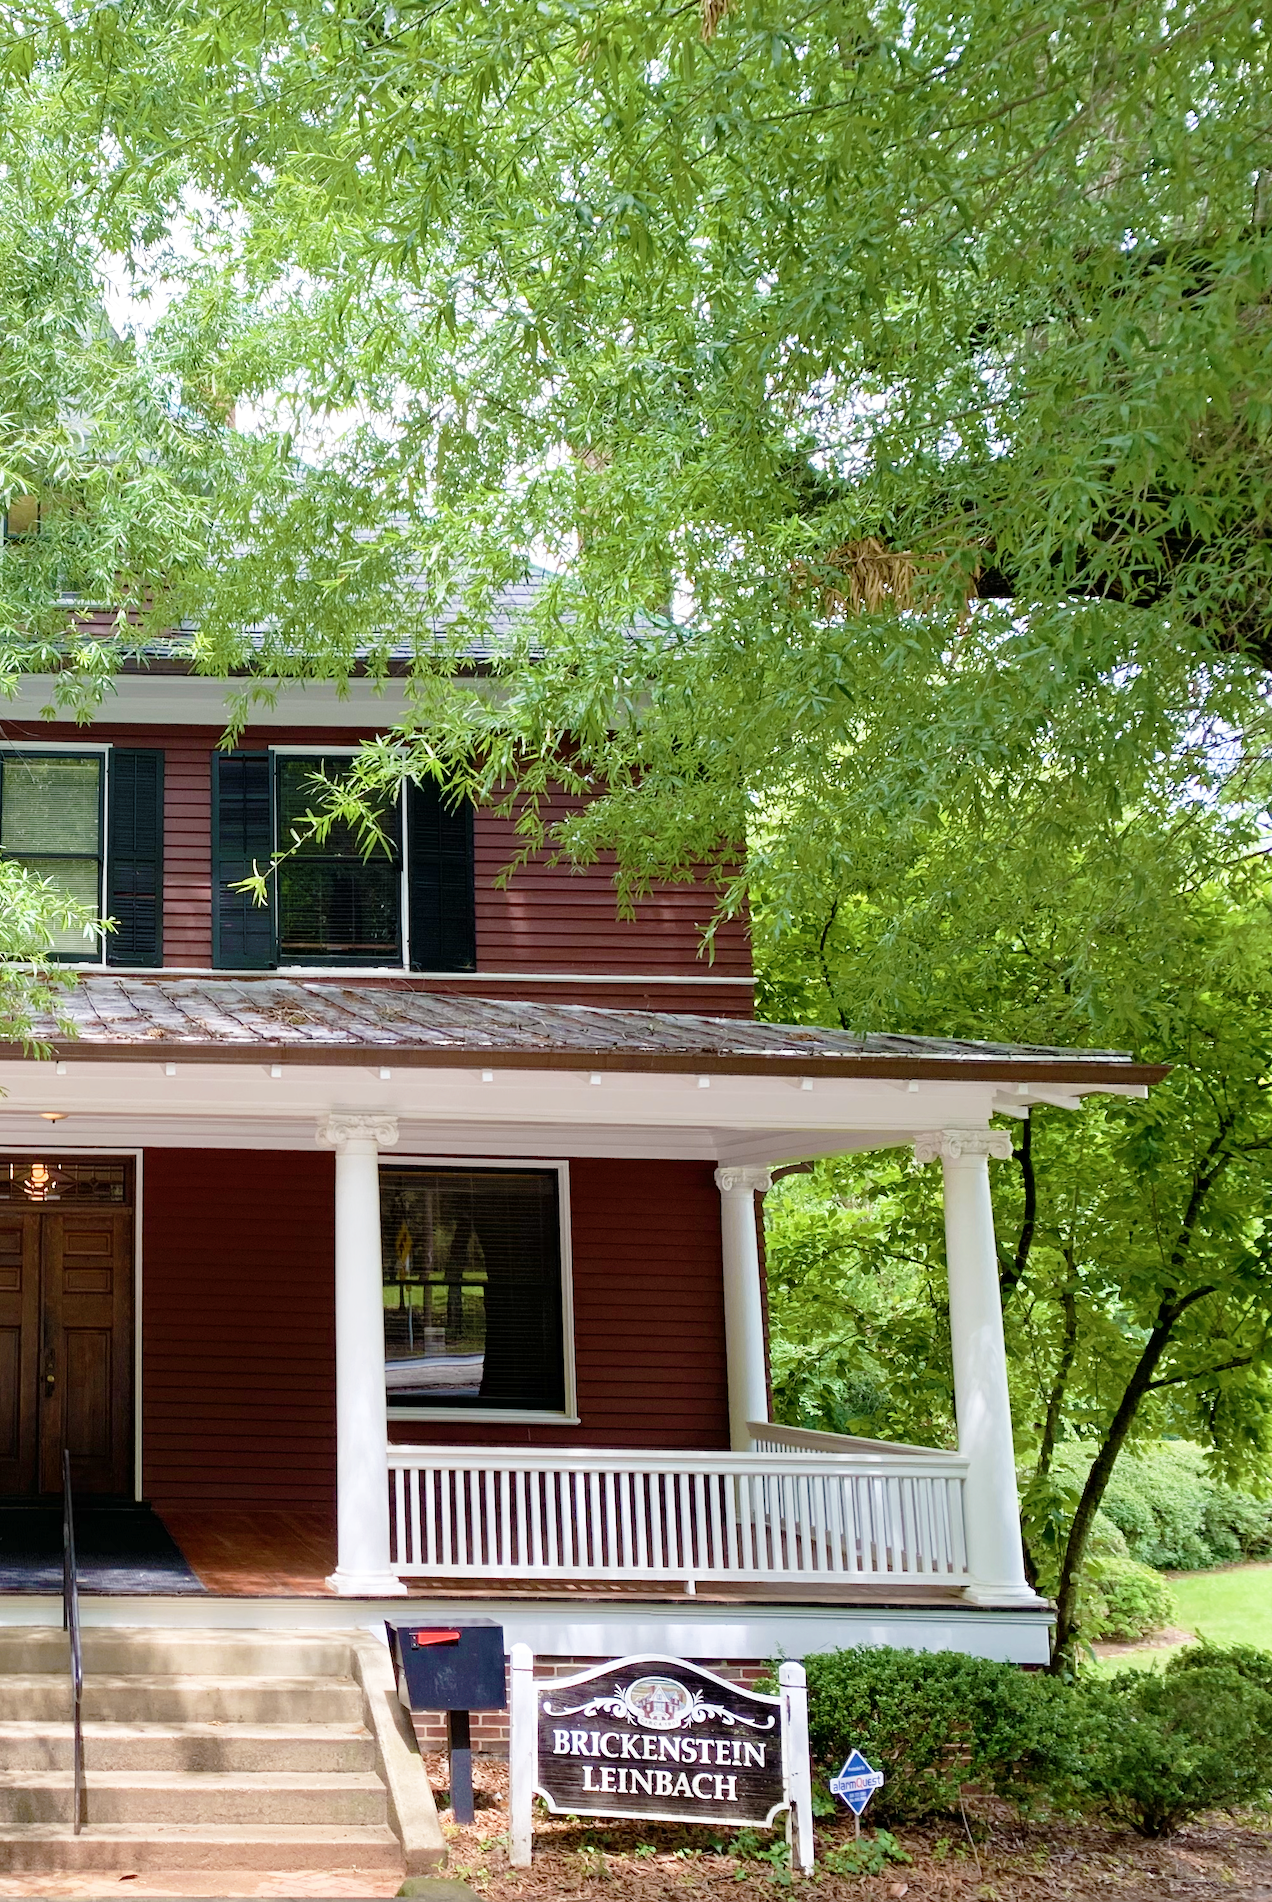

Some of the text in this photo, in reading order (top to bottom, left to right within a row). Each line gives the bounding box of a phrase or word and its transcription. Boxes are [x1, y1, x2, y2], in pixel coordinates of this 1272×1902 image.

[553, 1729, 767, 1768] BRICKENSTEIN
[582, 1765, 739, 1801] LEINBACH
[833, 1775, 881, 1792] alarmQuest
